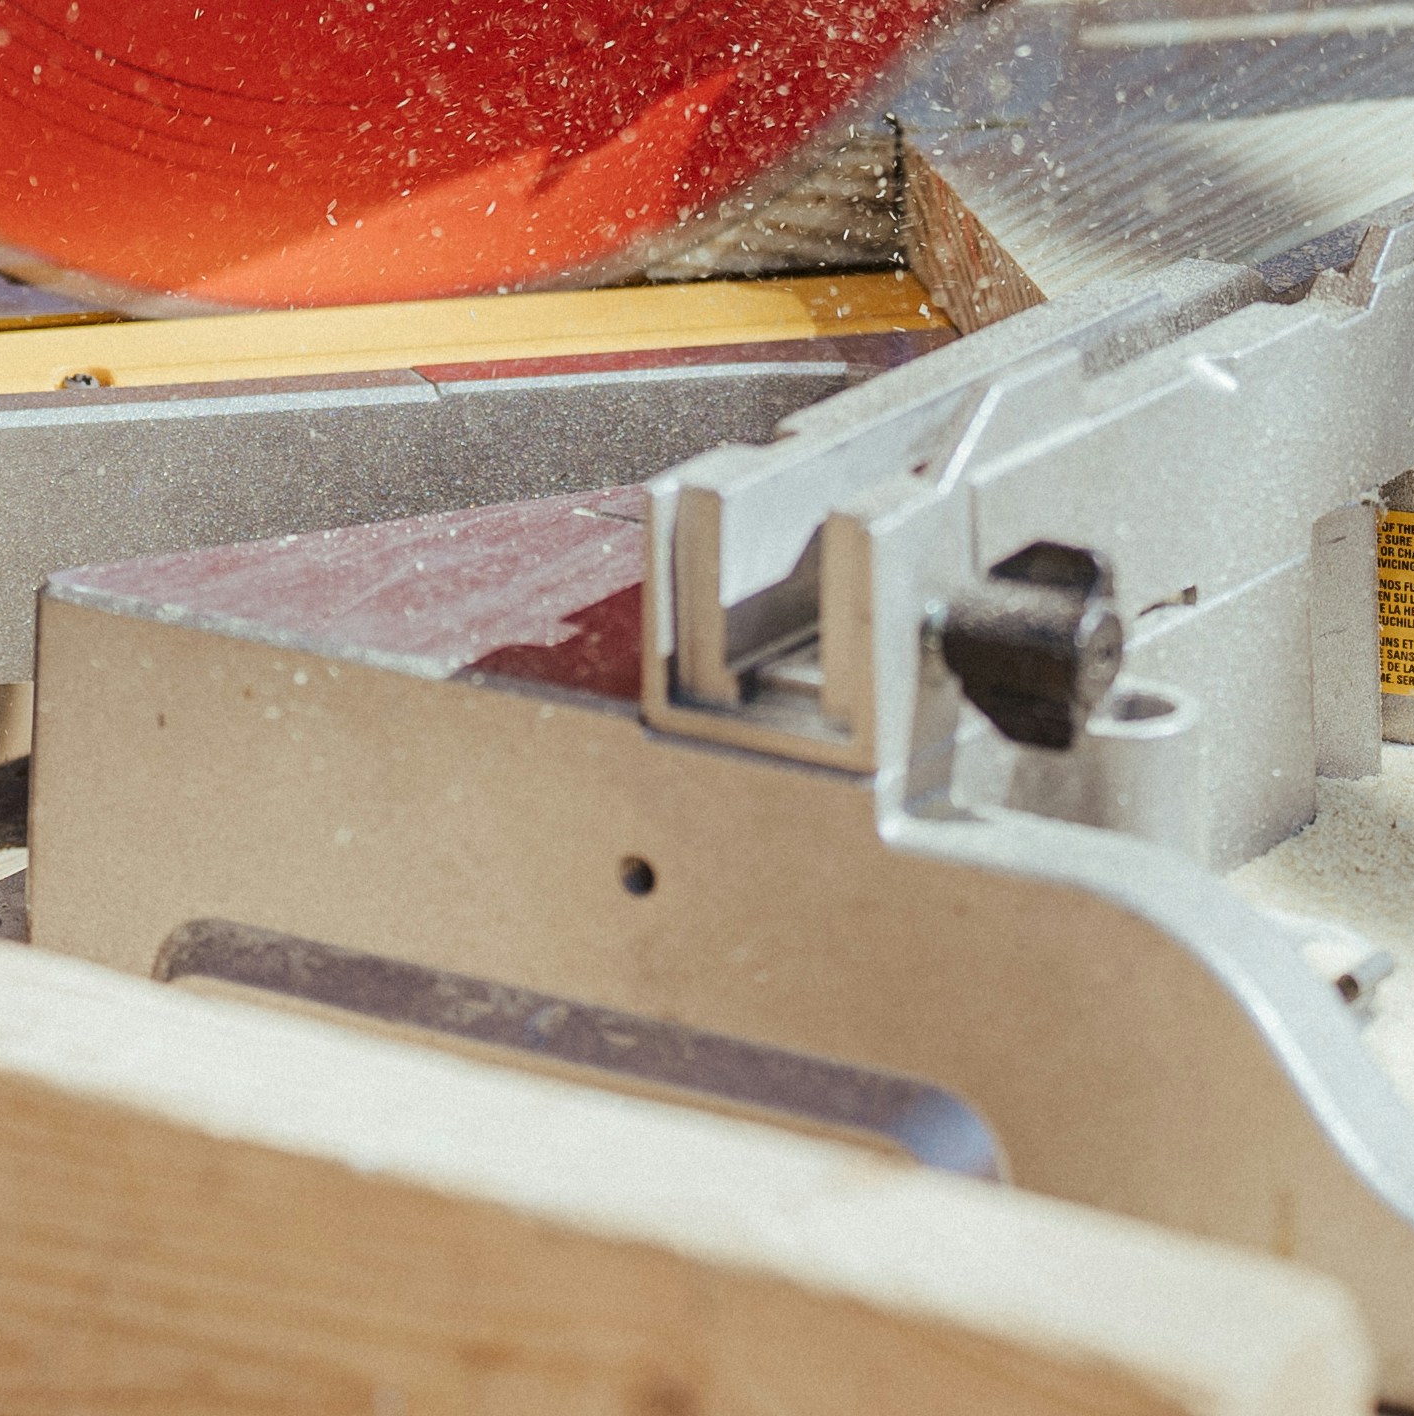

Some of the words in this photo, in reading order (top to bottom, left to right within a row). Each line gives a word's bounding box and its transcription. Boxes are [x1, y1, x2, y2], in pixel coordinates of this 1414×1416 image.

[1384, 534, 1413, 547] SURE
[1380, 546, 1395, 558] OR
[1393, 593, 1407, 604] SU
[1387, 604, 1401, 616] LA
[1402, 639, 1413, 650] ET
[1385, 649, 1414, 662] SANS
